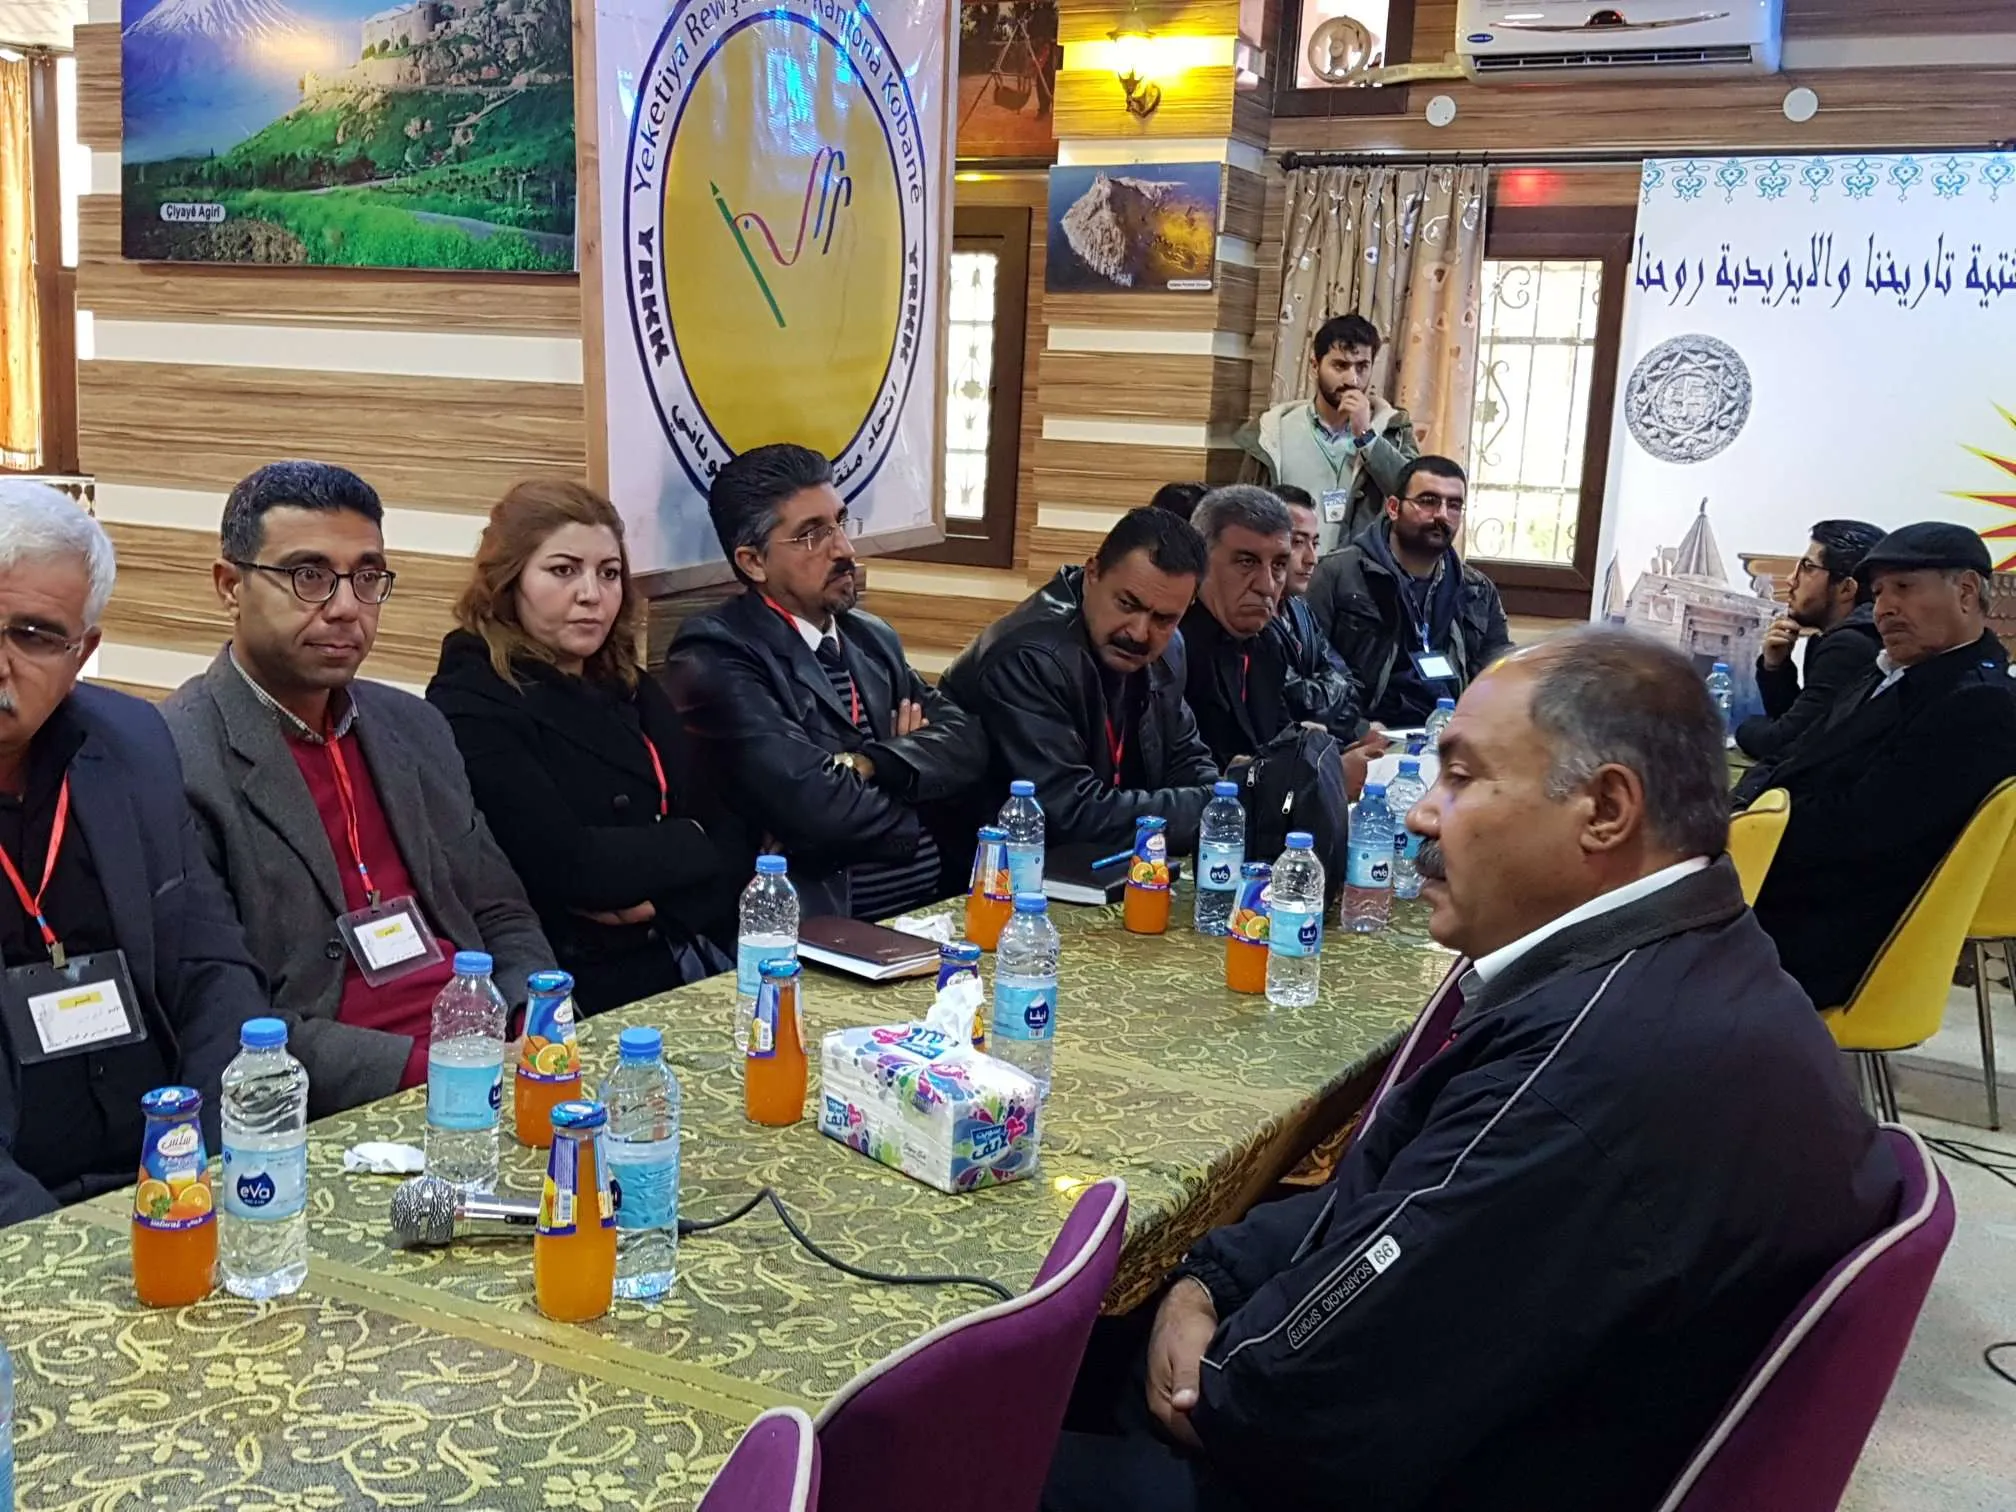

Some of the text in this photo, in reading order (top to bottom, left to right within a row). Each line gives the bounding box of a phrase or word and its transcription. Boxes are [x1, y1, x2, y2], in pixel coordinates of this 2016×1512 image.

[880, 73, 920, 204] Kobanê
[638, 226, 671, 367] YRKK
[899, 240, 918, 366] YRKK
[1635, 231, 1704, 307] روحنا
[1865, 231, 1955, 310] تاريخنا
[670, 404, 718, 478] وباني
[867, 379, 897, 453] اتحاد
[1290, 1308, 1322, 1343] SPORTS
